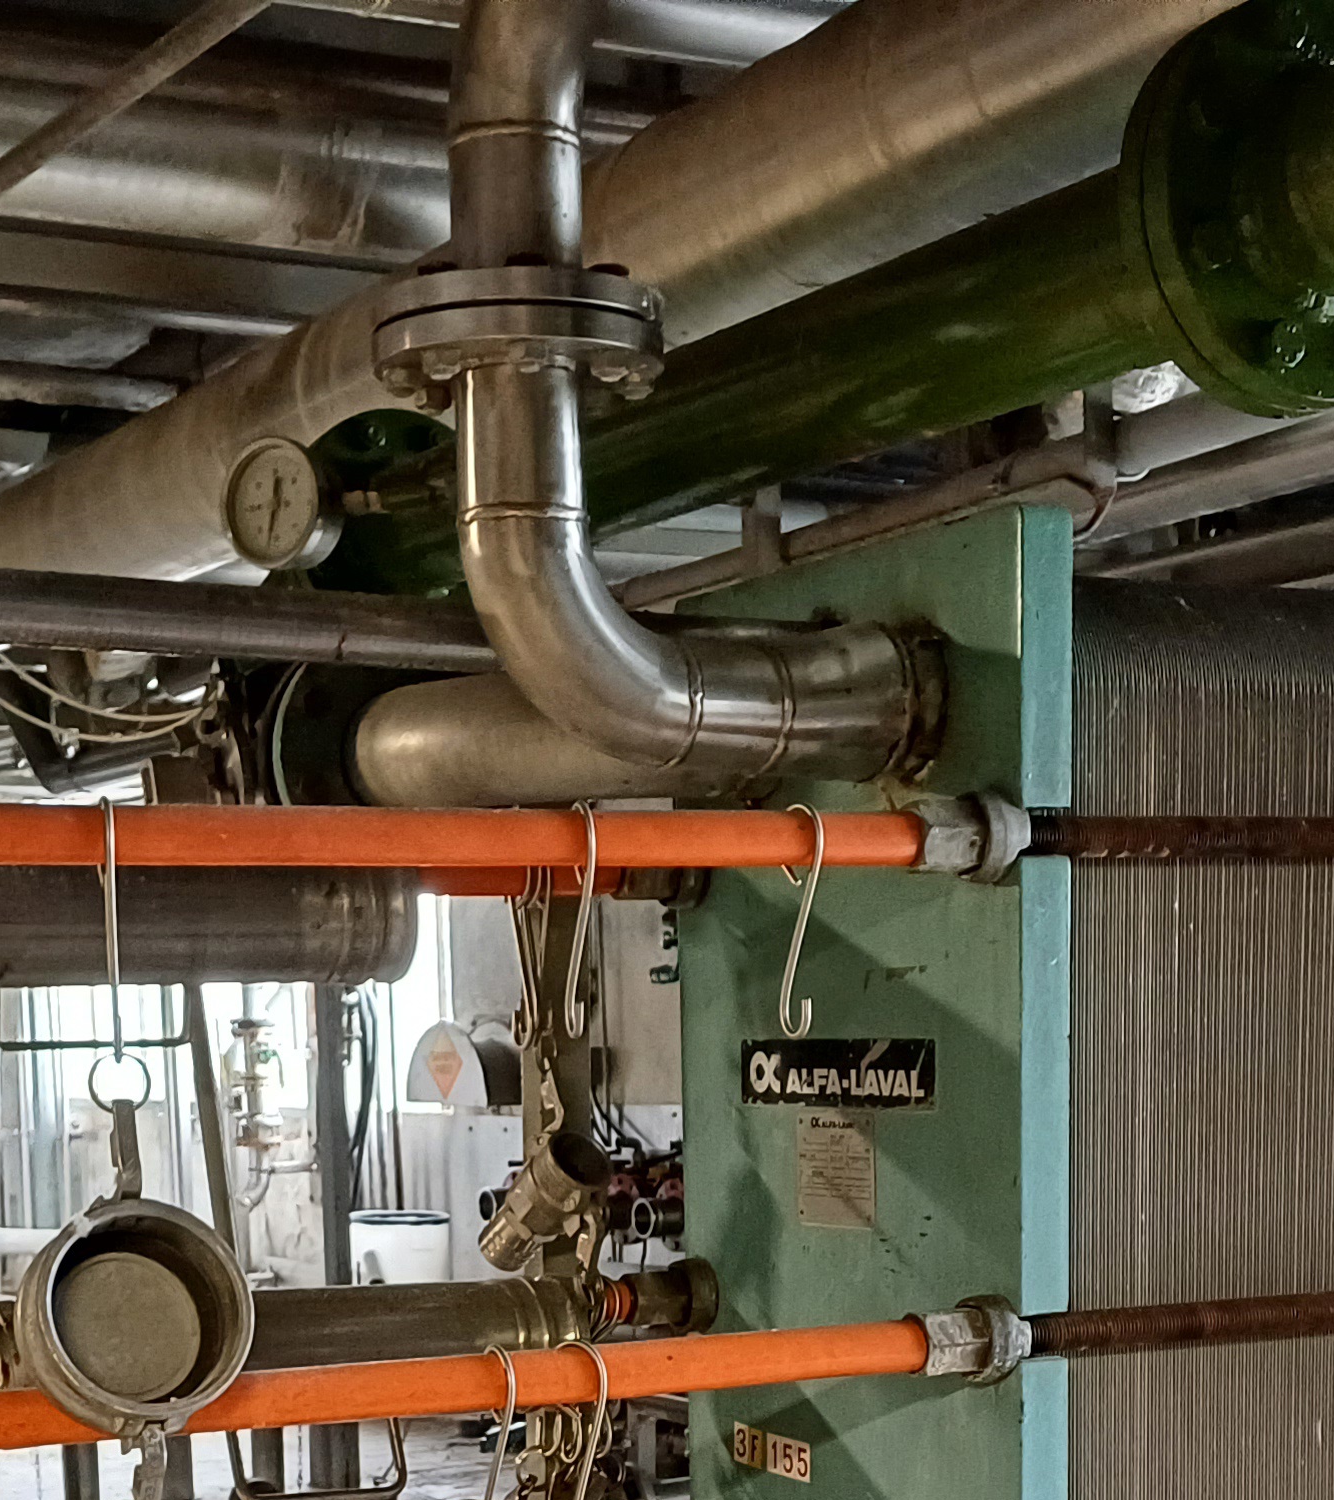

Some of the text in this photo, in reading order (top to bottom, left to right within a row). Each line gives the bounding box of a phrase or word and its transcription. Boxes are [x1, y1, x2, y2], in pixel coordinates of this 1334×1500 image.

[785, 1067, 925, 1097] ALFA-LAVAL
[735, 1428, 808, 1477] 3F 155
